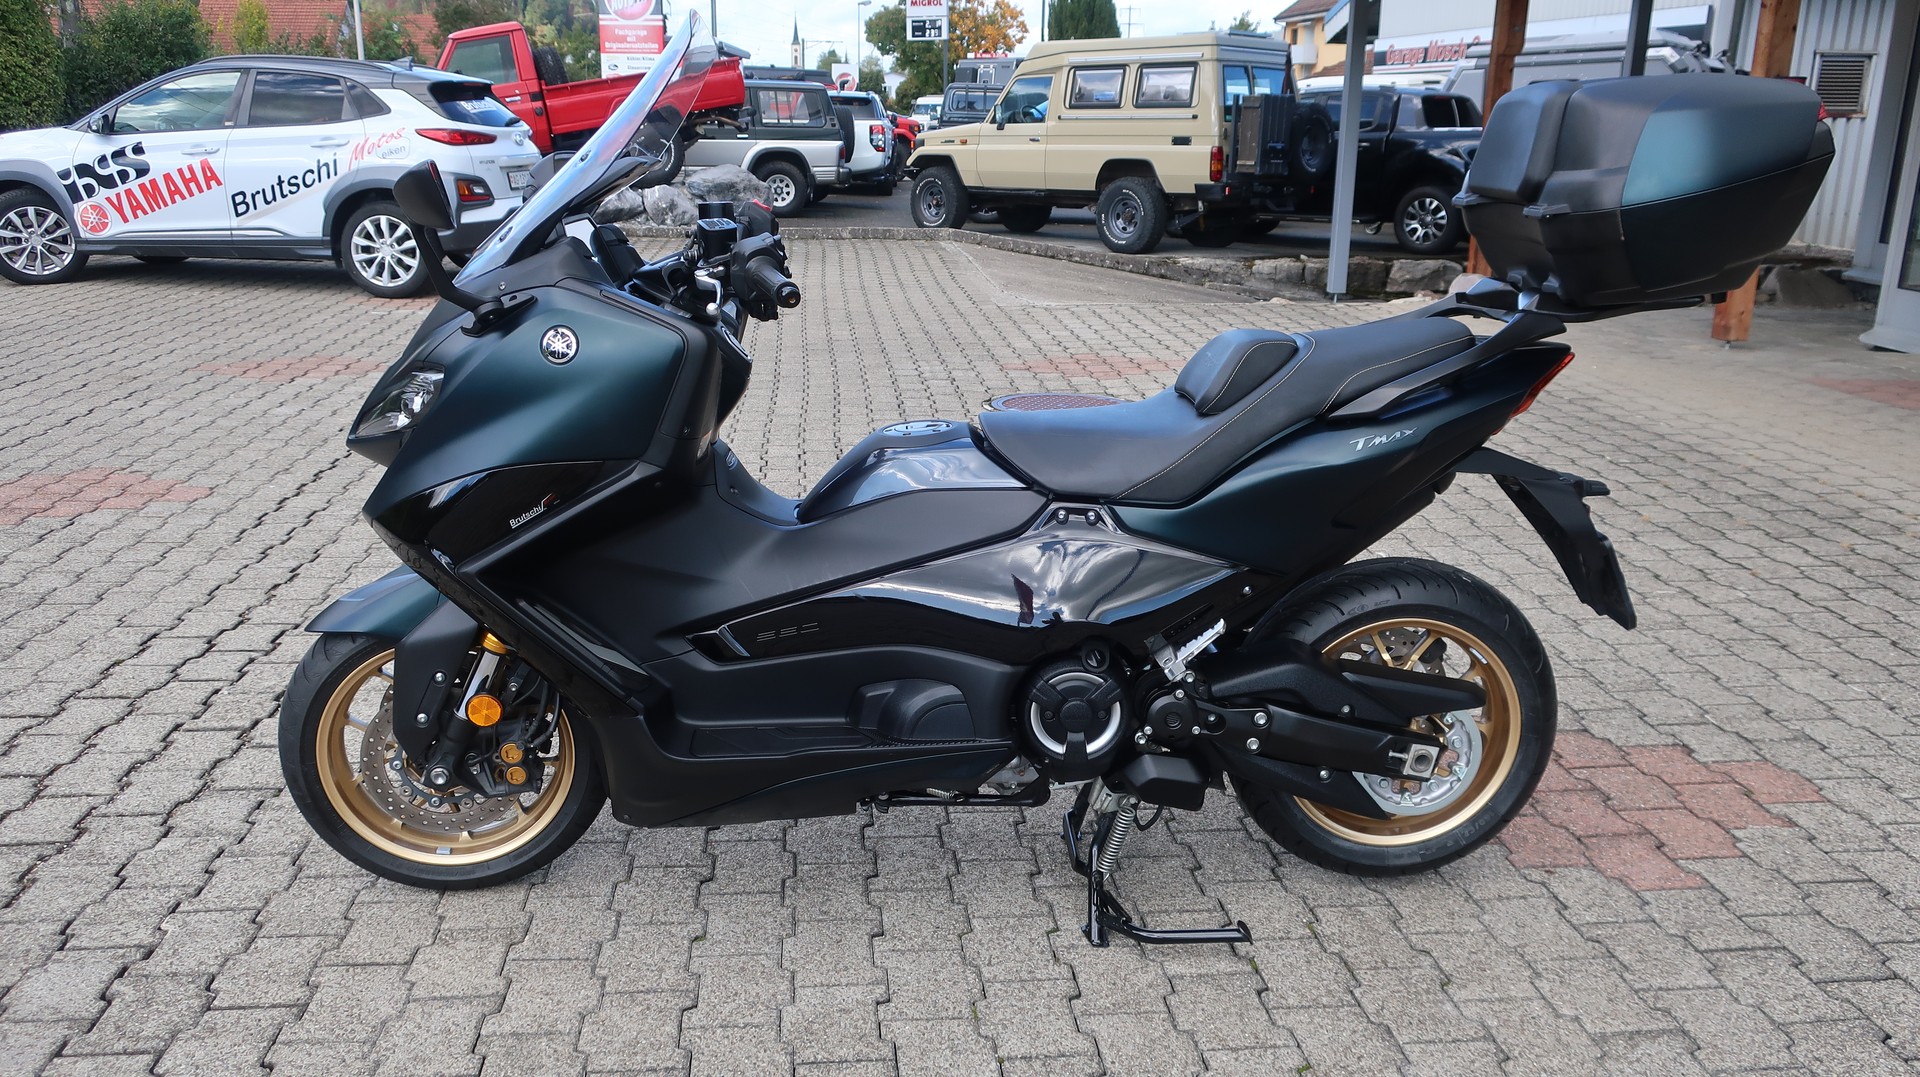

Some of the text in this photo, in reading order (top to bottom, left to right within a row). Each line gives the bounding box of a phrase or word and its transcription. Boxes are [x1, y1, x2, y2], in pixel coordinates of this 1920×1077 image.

[1386, 43, 1425, 67] Garage
[348, 127, 406, 171] Motos
[381, 144, 406, 159] eiken
[104, 157, 223, 224] YAMAHA
[231, 151, 338, 218] Brutschi
[509, 504, 542, 527] Brutschi
